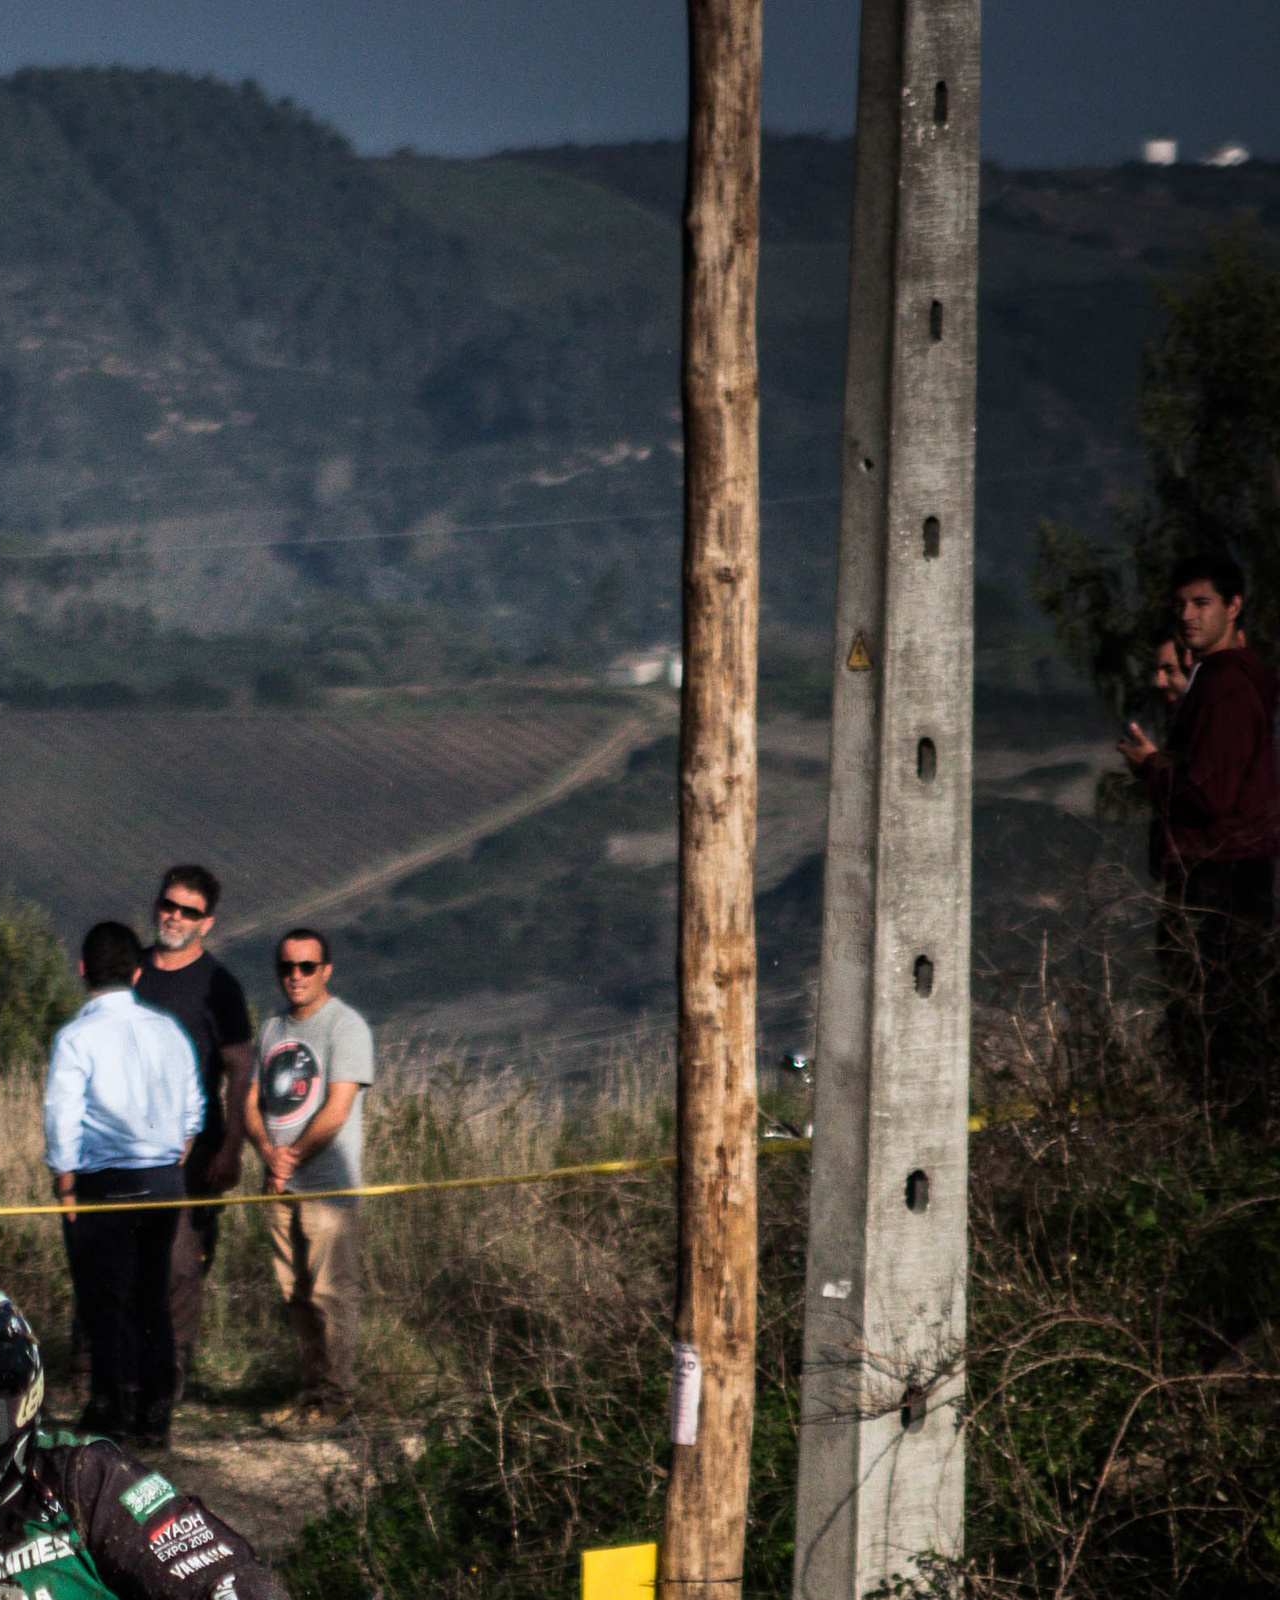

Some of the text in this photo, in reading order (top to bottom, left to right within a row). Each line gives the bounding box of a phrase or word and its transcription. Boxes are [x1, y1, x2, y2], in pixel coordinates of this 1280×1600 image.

[150, 1513, 205, 1551] RIYADH
[157, 1542, 188, 1563] EXPO
[189, 1530, 215, 1549] 2030
[170, 1543, 234, 1580] YAMAHA
